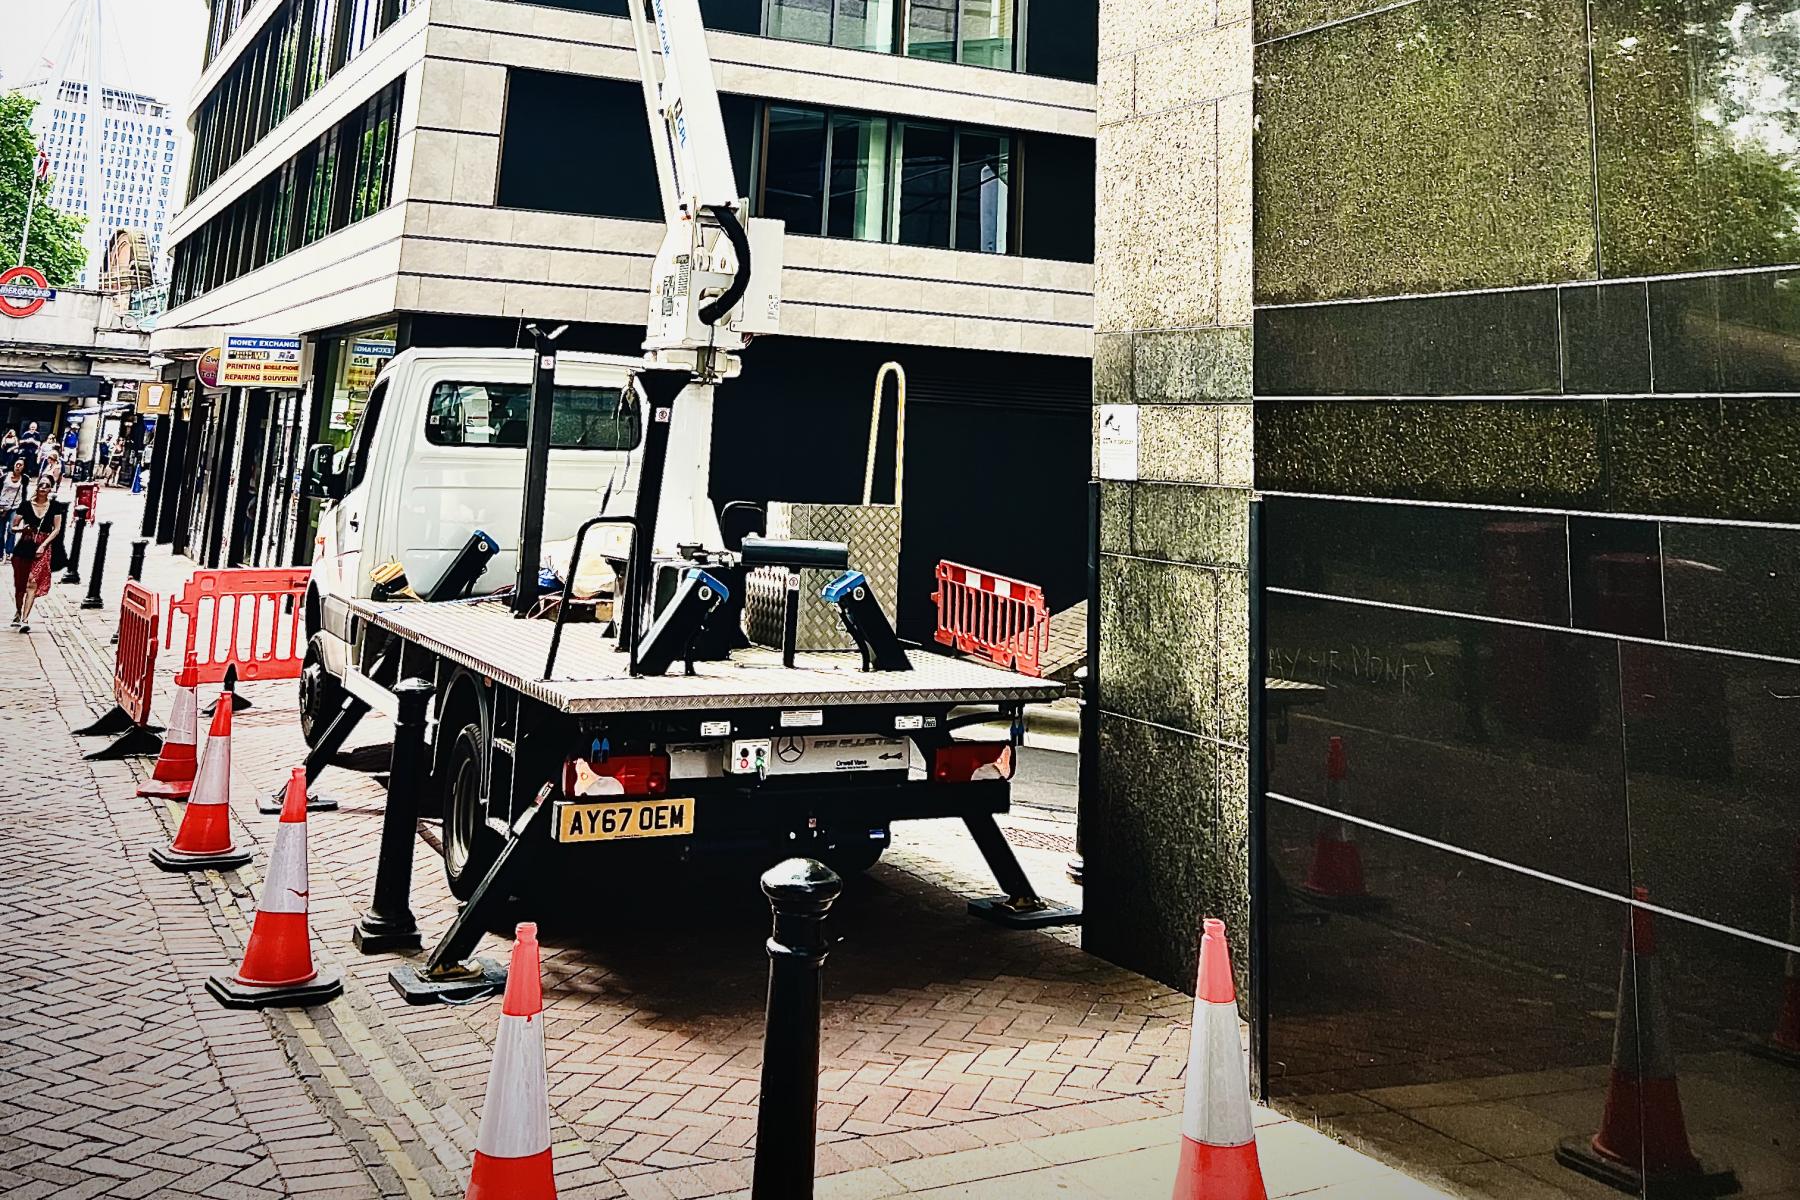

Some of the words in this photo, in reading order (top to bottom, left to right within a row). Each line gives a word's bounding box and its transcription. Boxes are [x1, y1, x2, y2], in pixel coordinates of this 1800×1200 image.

[677, 117, 687, 149] CPL
[230, 339, 257, 347] MONEY
[259, 340, 300, 348] EXCHANGE
[226, 363, 261, 371] PRINTING
[224, 373, 260, 382] REPAIRING
[35, 382, 63, 390] STATION
[569, 808, 633, 835] AY67
[638, 805, 684, 831] OEM
